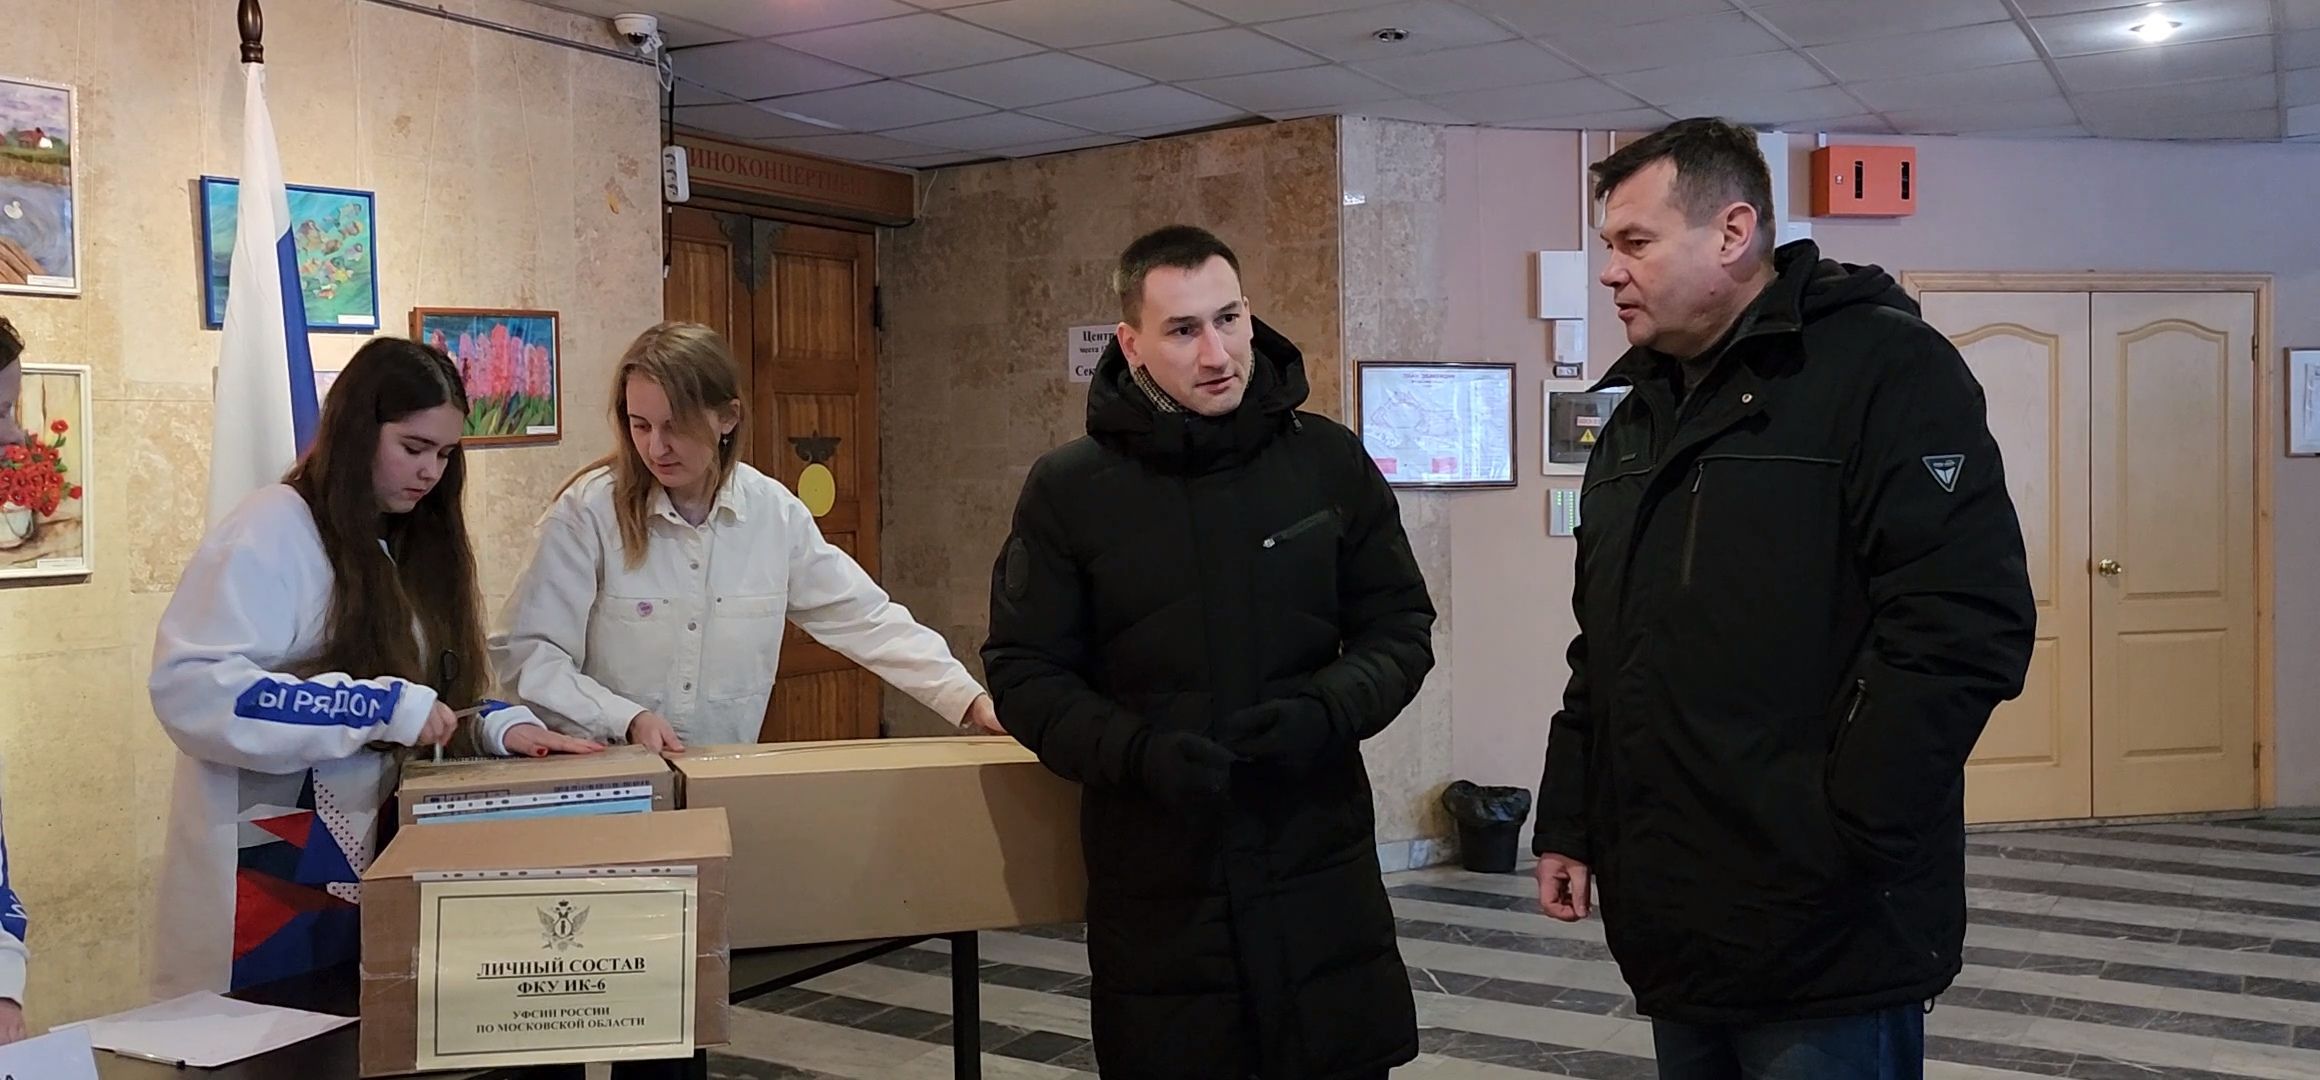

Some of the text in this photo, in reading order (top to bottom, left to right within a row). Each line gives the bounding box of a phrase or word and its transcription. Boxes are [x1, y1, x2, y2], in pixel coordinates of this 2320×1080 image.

[476, 956, 646, 977] ЛИЧНЫЙ СОСТАВ
[517, 977, 607, 995] ФКУ ИК-6
[512, 1006, 611, 1020] УФСИН РОССИИ
[476, 1016, 646, 1034] ПО МОСКОВСКОЙ ОБЛАСТИ
